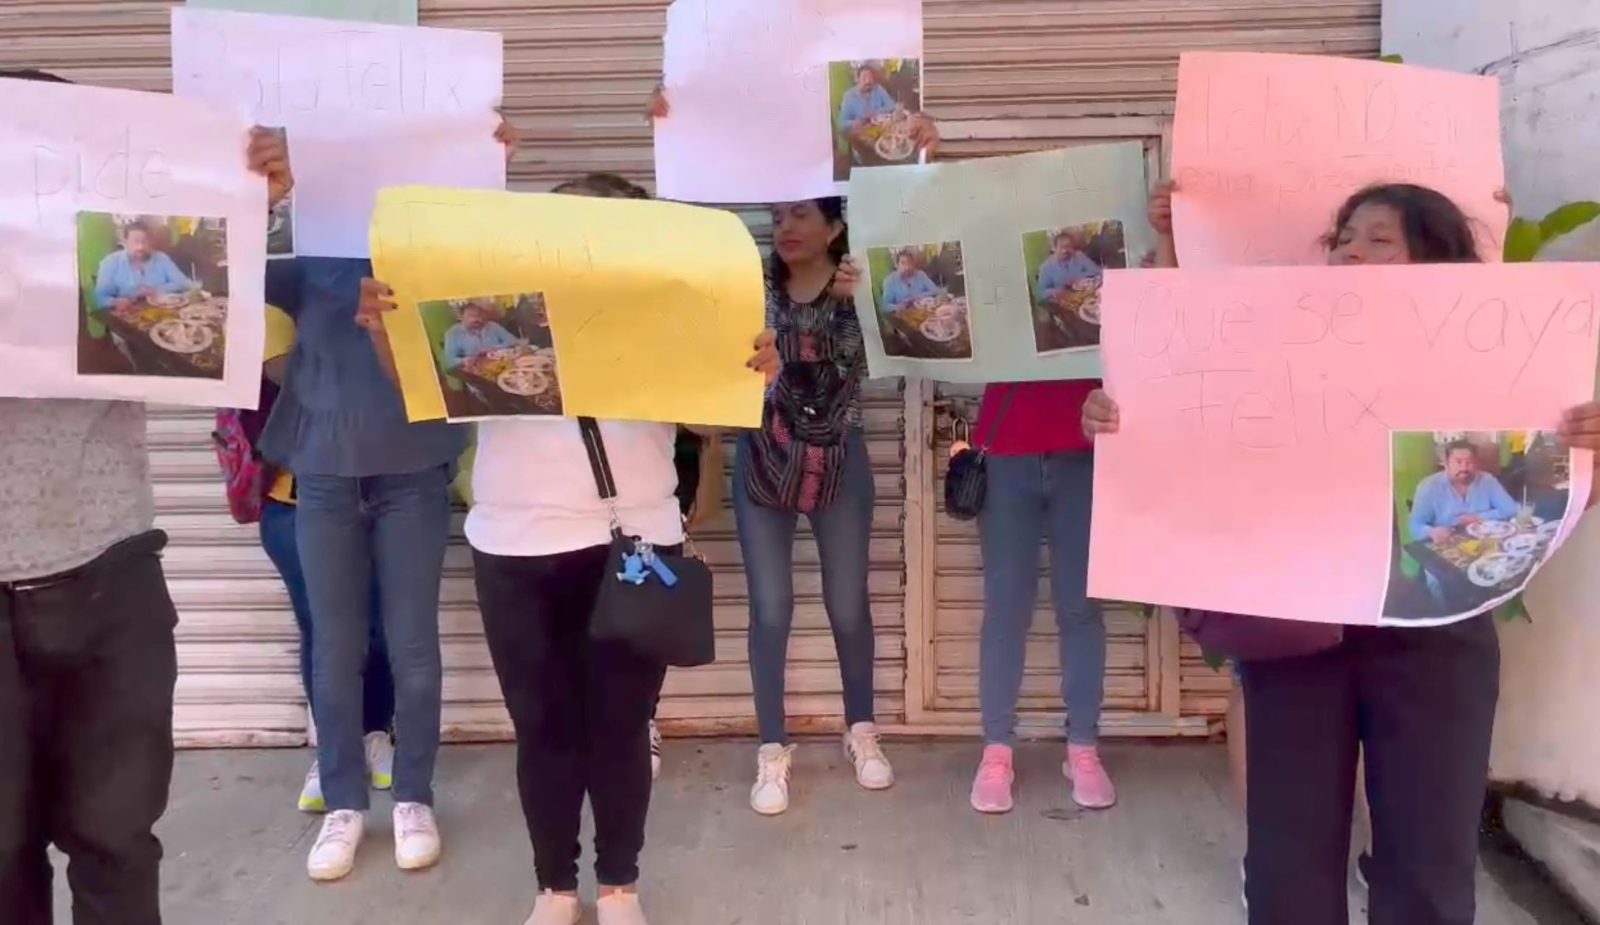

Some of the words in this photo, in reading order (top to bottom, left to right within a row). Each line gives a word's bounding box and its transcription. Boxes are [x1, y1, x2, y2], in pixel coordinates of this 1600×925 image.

[1133, 280, 1254, 374] Que
[1282, 291, 1367, 344] se
[1146, 355, 1392, 448] Felix
